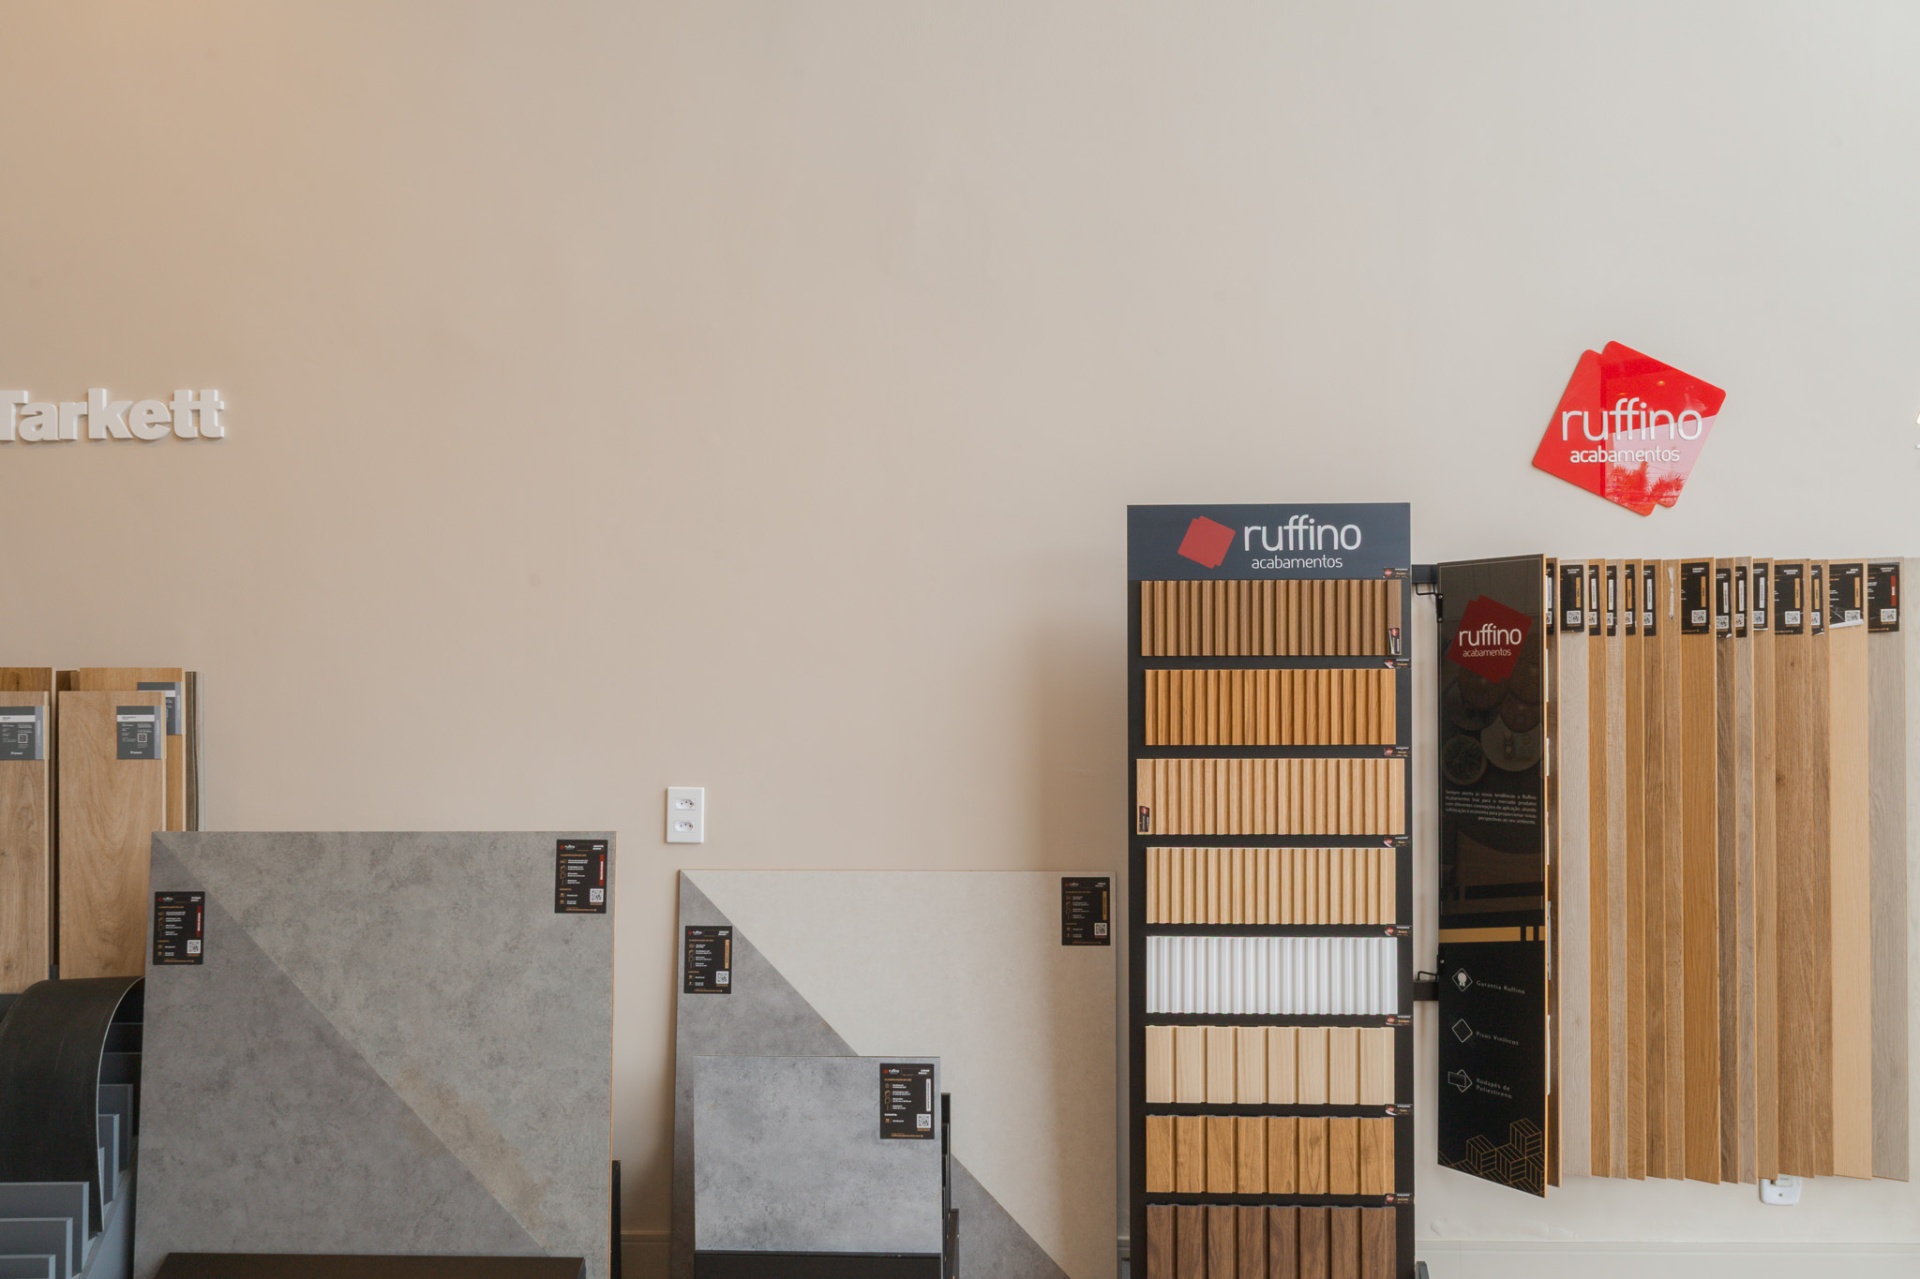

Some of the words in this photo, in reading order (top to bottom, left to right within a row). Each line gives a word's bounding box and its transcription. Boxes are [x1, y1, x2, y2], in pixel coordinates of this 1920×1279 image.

[0, 388, 225, 442] Tarkett
[1562, 397, 1703, 441] ruffino
[1570, 445, 1681, 464] acabamentos
[1244, 514, 1362, 551] ruffino
[1251, 554, 1343, 569] acabamentos
[1459, 623, 1522, 647] ruffino
[1462, 647, 1512, 658] acabamentos
